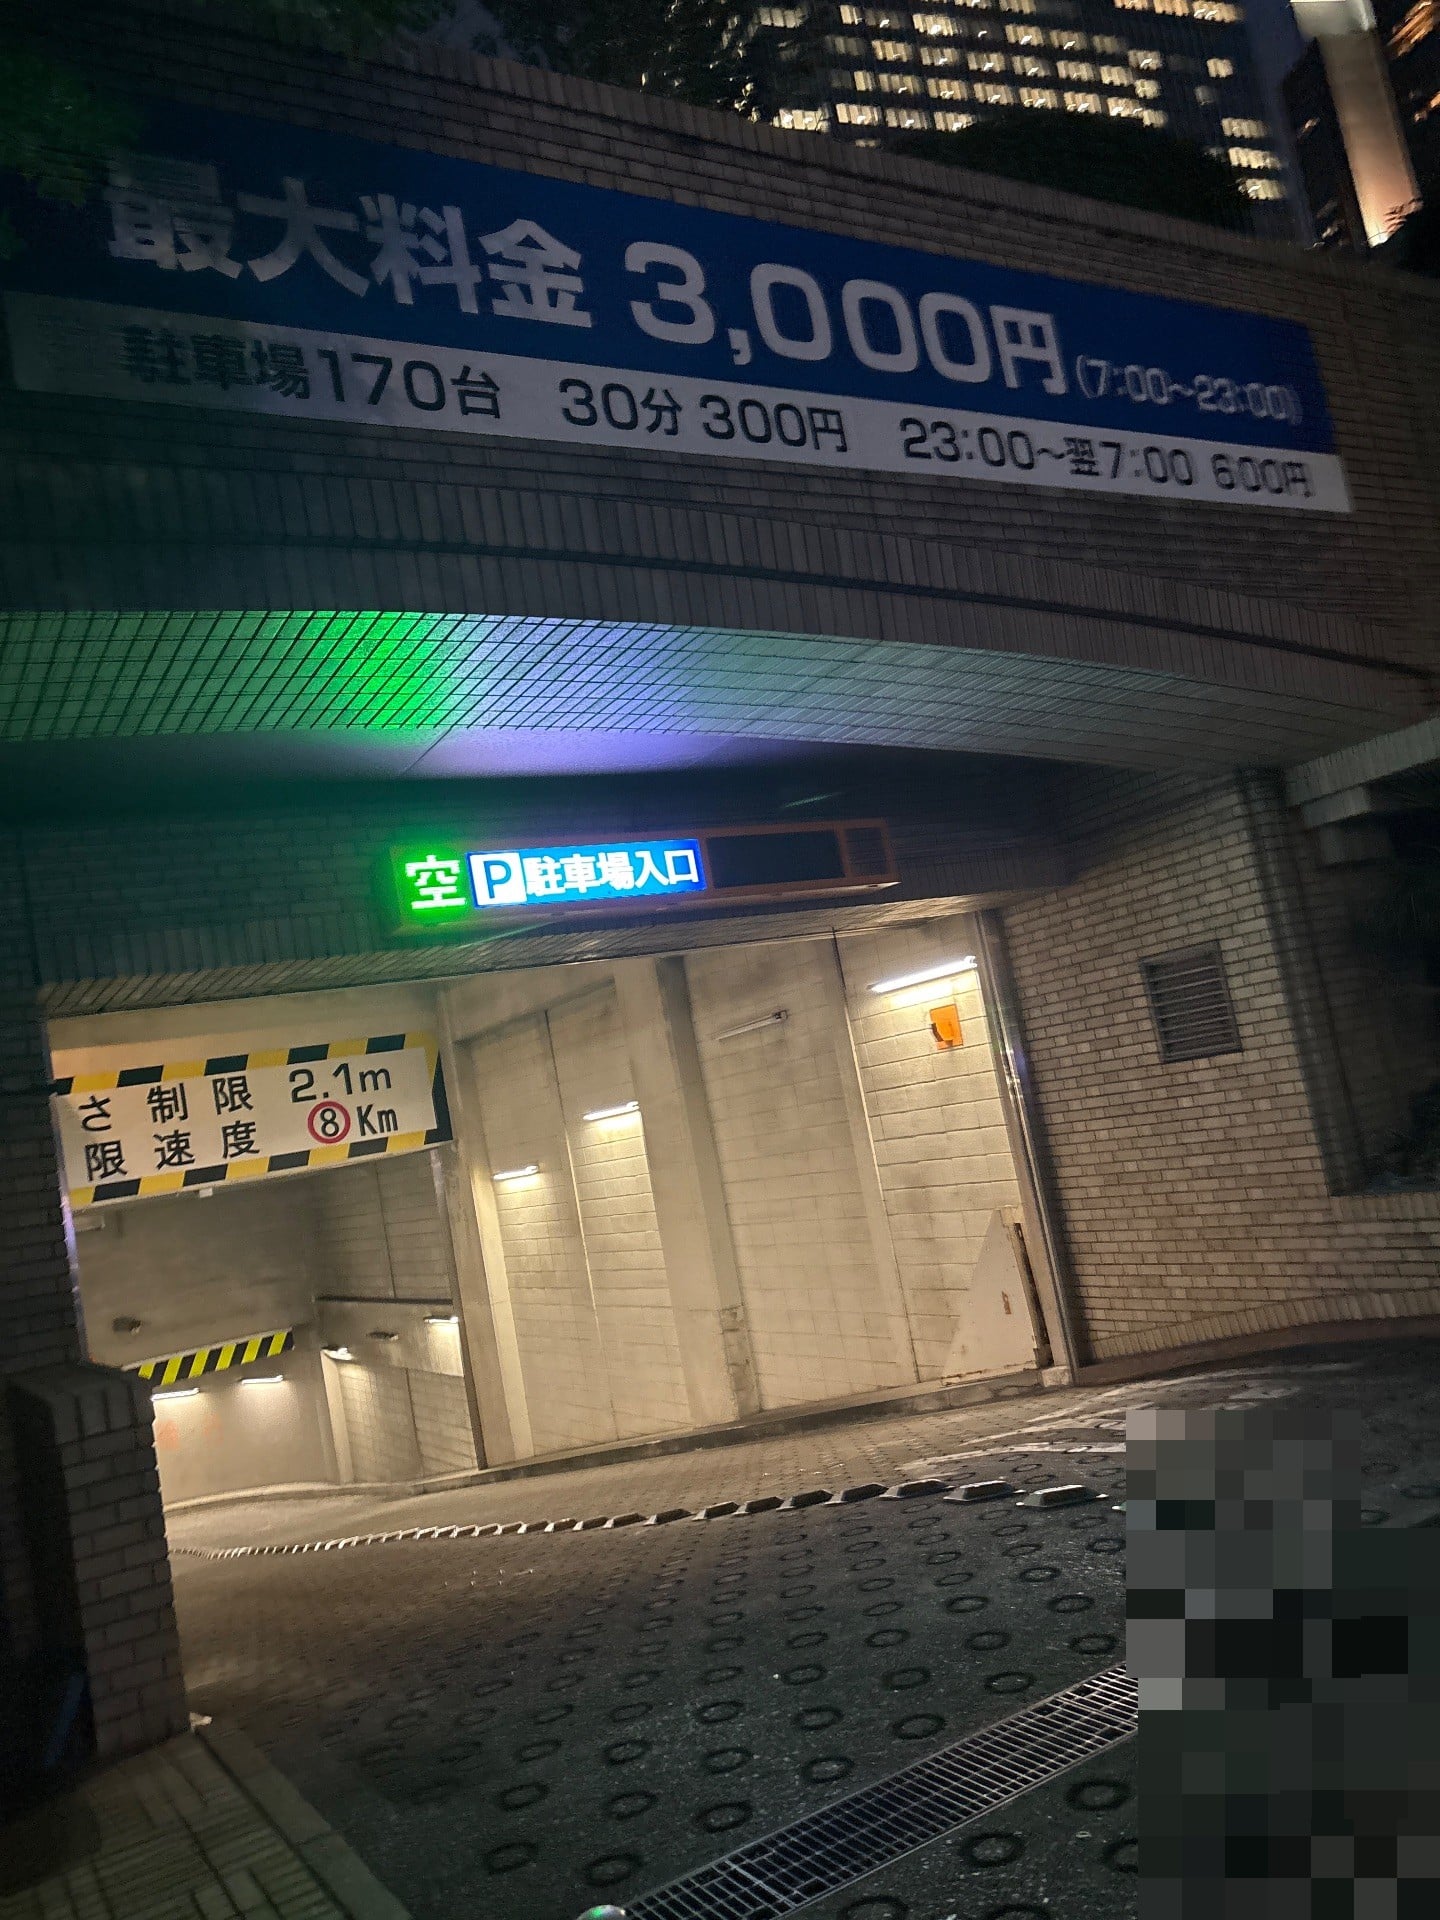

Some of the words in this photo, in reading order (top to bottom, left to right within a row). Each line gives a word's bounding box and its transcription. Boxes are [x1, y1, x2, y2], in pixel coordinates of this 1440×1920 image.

[105, 148, 594, 328] 最大料金
[624, 240, 1068, 395] 3,000円
[560, 378, 683, 435] 30分
[701, 396, 848, 453] 300円
[1211, 453, 1313, 498] 600円
[405, 855, 466, 910] 空
[523, 848, 699, 897] 駐車場入口
[288, 1063, 392, 1104] 2.1m
